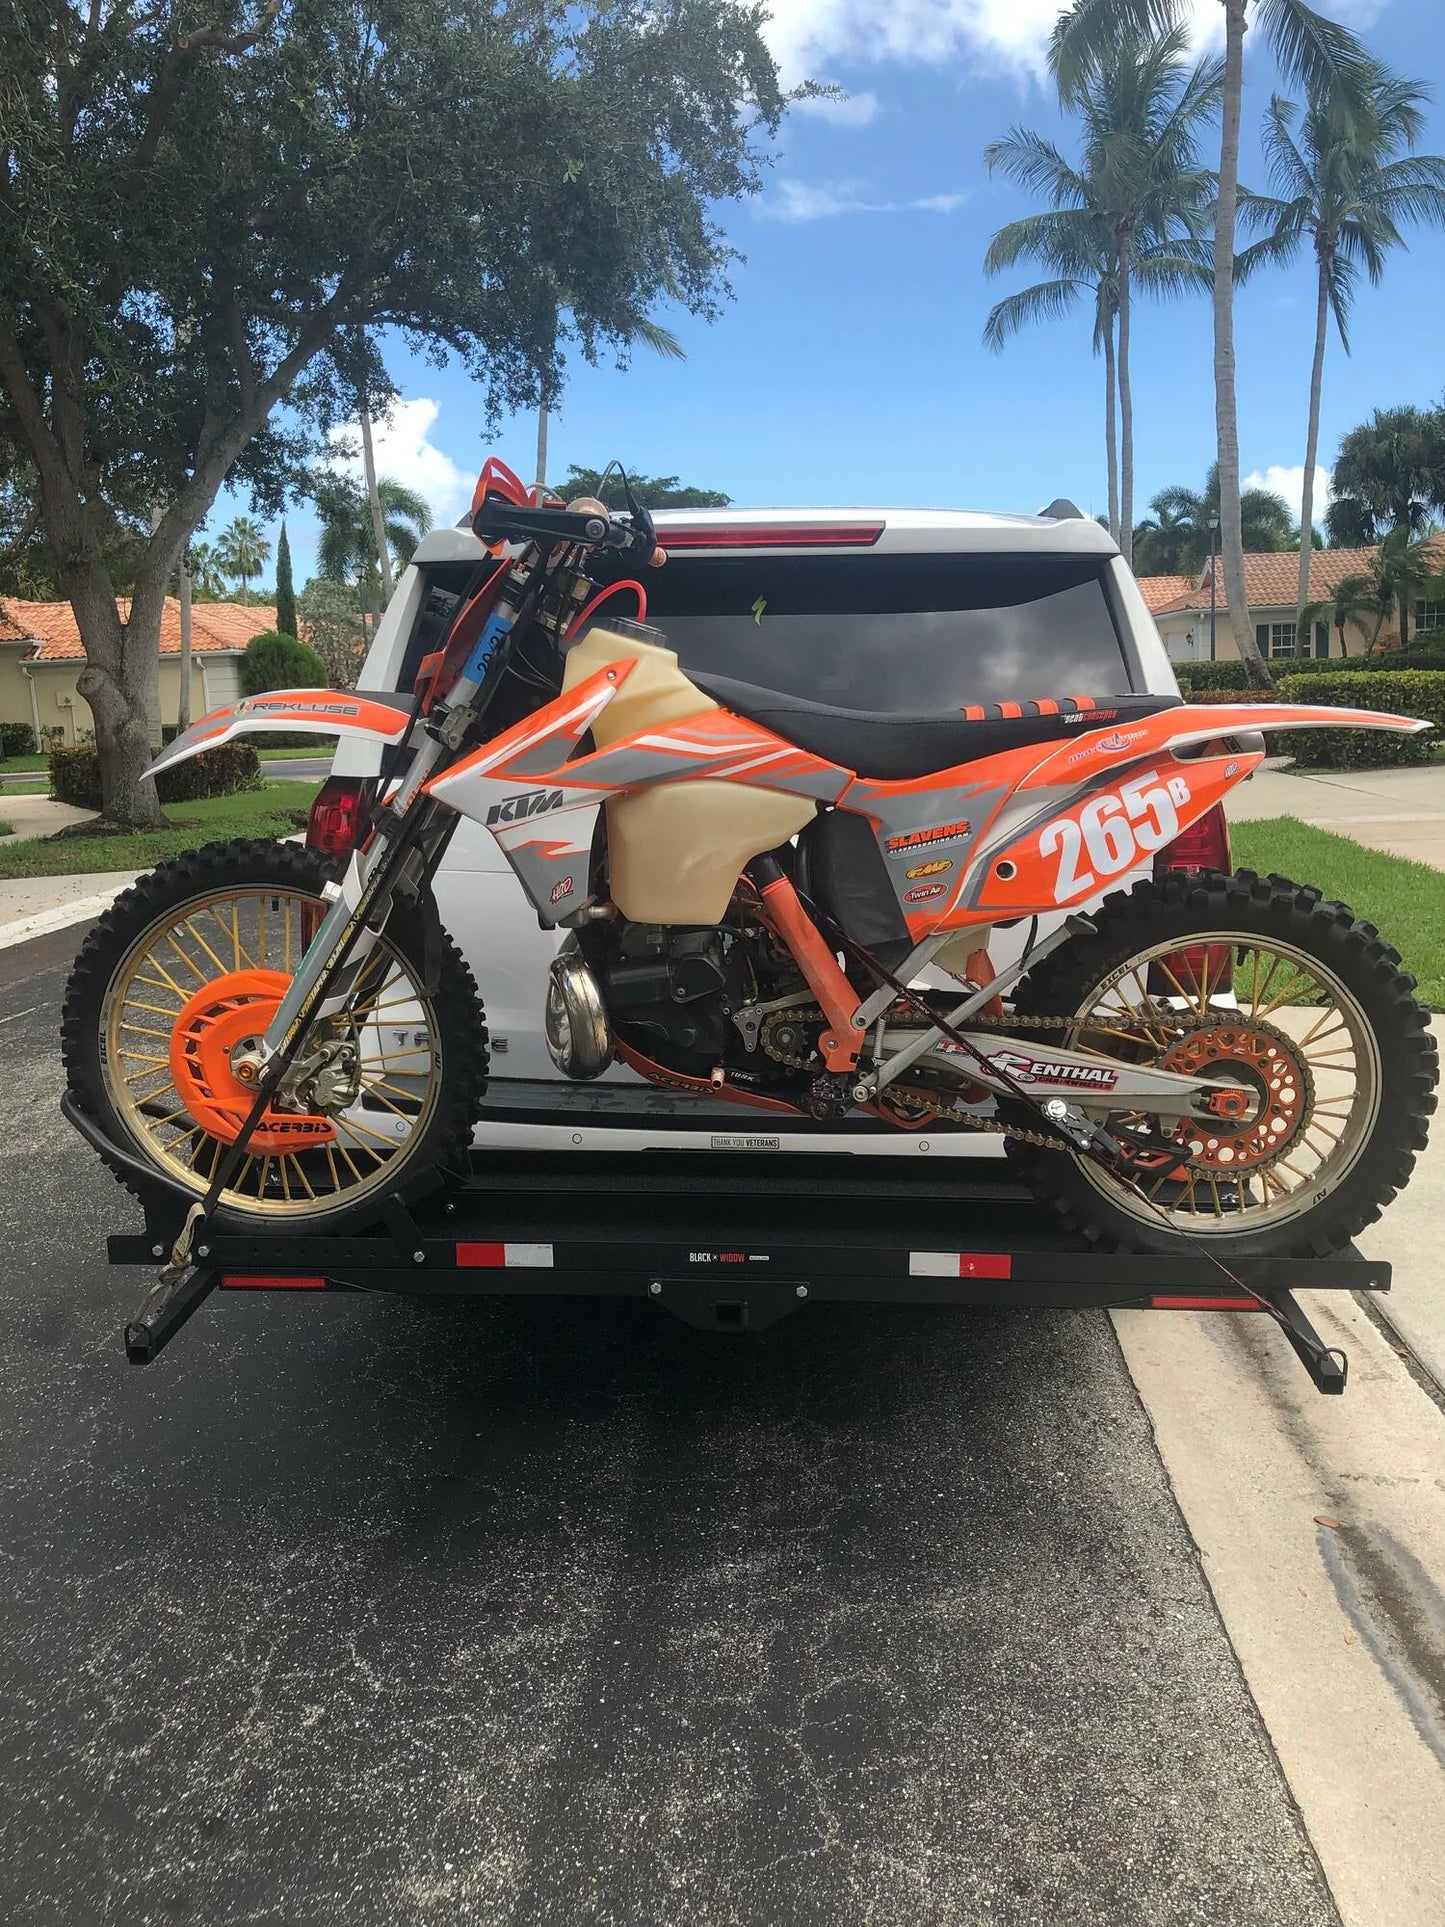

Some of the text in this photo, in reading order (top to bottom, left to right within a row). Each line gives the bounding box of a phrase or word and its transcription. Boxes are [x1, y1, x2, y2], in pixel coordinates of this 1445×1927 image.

[252, 702, 359, 716] REKLUSE
[486, 789, 563, 825] KTM
[888, 821, 969, 850] SLAVENS
[1039, 770, 1192, 905] 265 B
[906, 860, 952, 879] FMF
[910, 886, 942, 900] Twin Air
[1100, 963, 1132, 991] EXCEL
[99, 1030, 108, 1065] EXCEL
[980, 1051, 1118, 1084] RENTHAL
[254, 1121, 333, 1133] ACERBIS
[713, 1138, 778, 1148] THANK YOU VETERANS
[689, 1252, 712, 1263] BLACK
[719, 1252, 746, 1264] WIDOW
